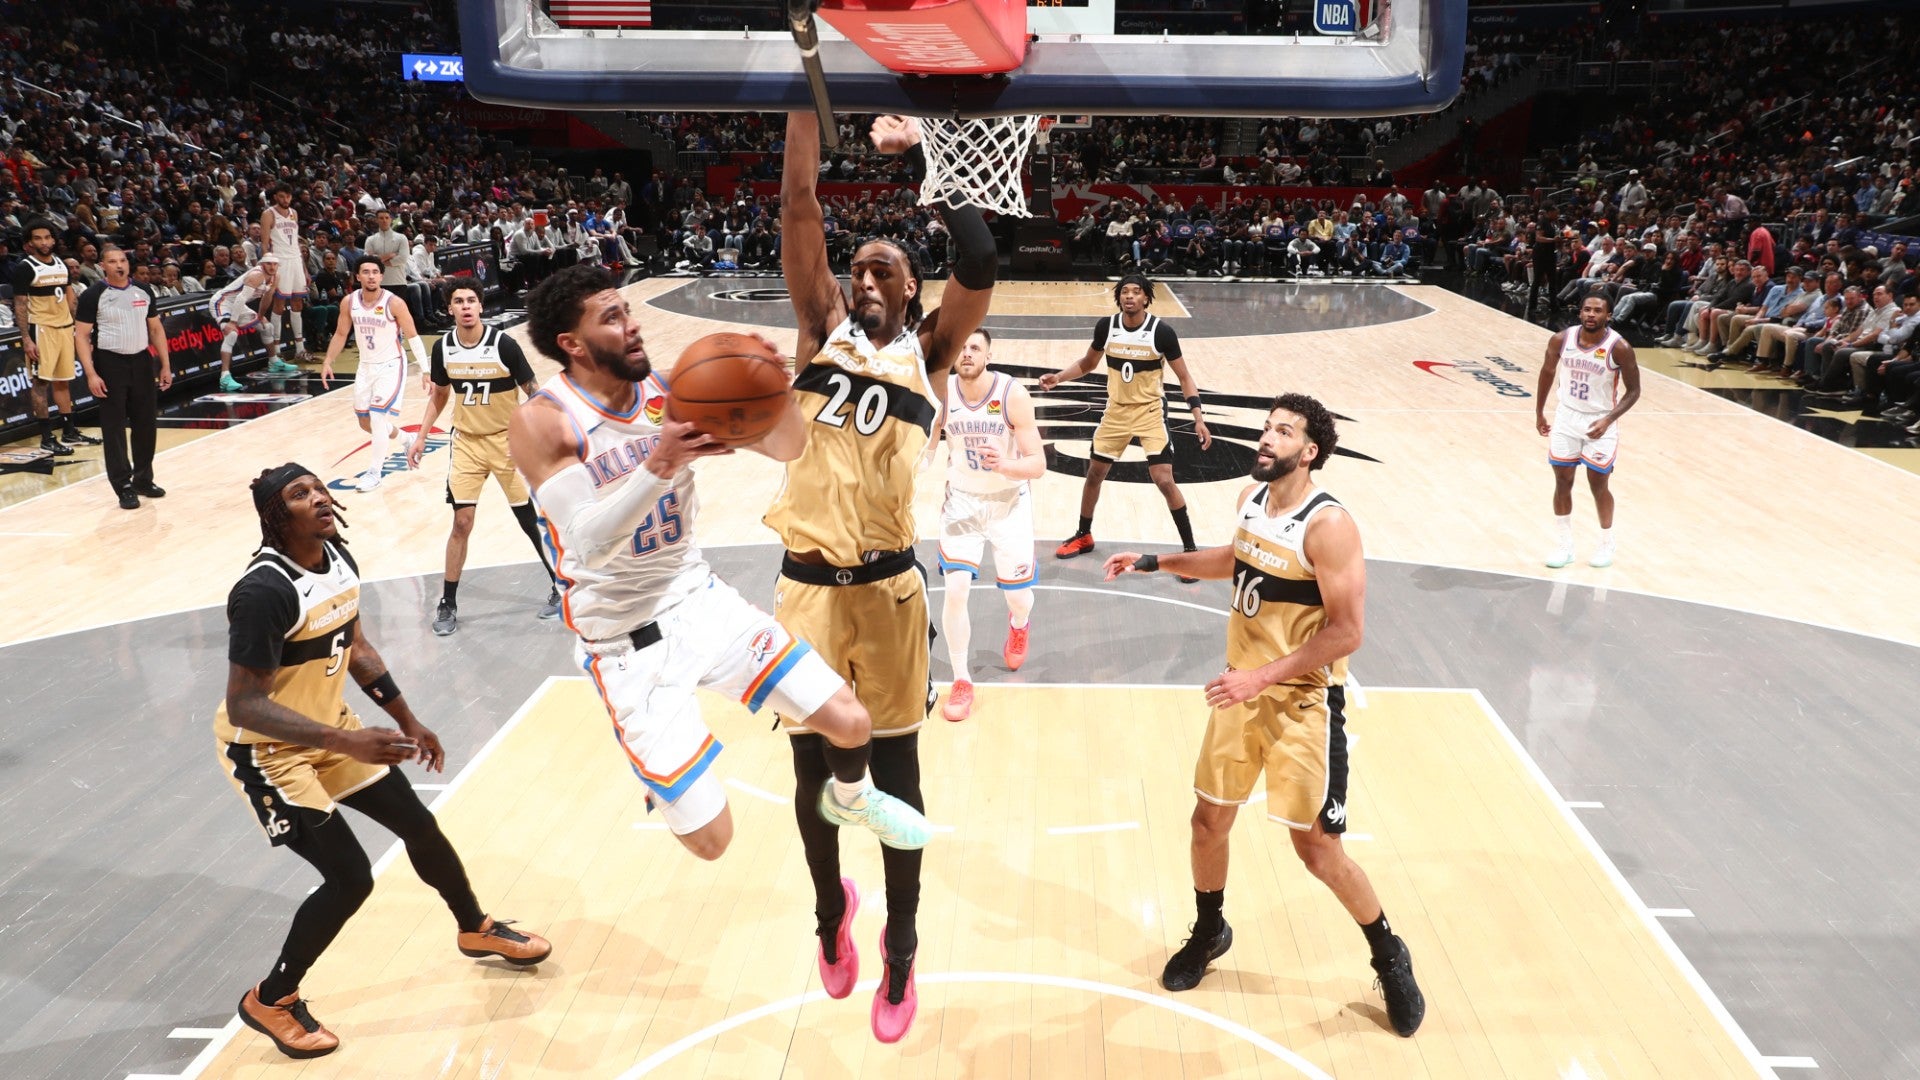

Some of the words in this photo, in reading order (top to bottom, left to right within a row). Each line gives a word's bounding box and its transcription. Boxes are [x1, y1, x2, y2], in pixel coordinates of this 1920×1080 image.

[1322, 4, 1349, 25] NBA
[287, 235, 293, 245] 7
[1018, 244, 1063, 255] CapitalOne
[54, 286, 64, 304] 9
[189, 329, 203, 350] by
[359, 326, 376, 335] CITY
[365, 335, 375, 350] 3
[1109, 346, 1150, 358] washington
[450, 364, 498, 377] washington
[1121, 361, 1134, 383] 0
[1571, 369, 1590, 381] CITY
[461, 381, 491, 406] 27
[1570, 380, 1590, 401] 22
[814, 373, 889, 436] 20
[947, 420, 1005, 436] OKLAHOMA
[964, 436, 988, 448] CITY
[631, 488, 684, 558] 25
[1230, 569, 1264, 618] 16
[325, 631, 346, 677] 5
